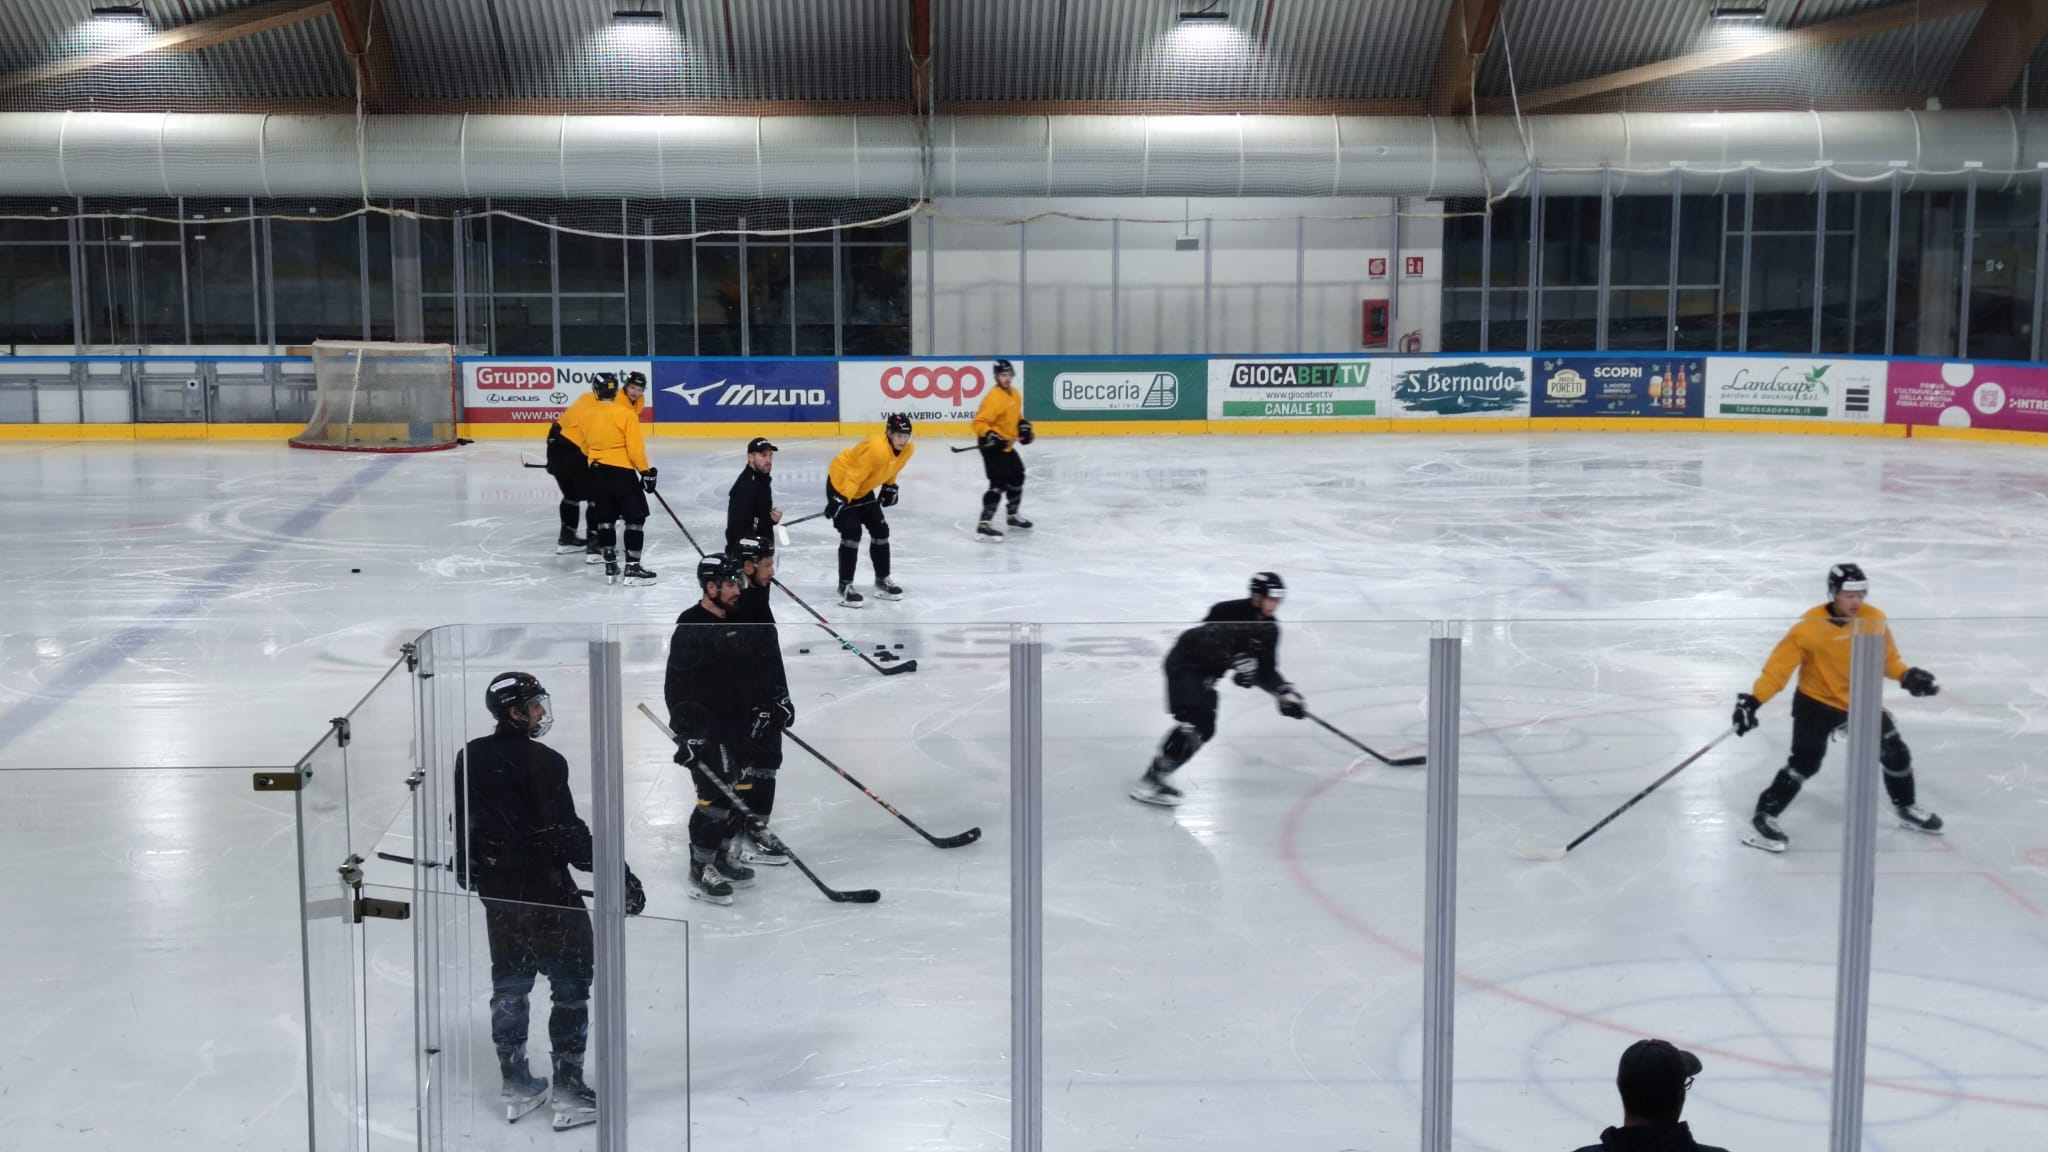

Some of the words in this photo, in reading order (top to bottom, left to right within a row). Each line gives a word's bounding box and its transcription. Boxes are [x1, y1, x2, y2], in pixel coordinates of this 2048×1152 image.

[478, 367, 551, 388] Gruppo
[1236, 365, 1367, 385] GIOCABET.TV
[1594, 367, 1642, 377] SCOPRI
[880, 366, 986, 406] coop
[1062, 380, 1140, 400] Beccaria
[1551, 382, 1582, 393] PORETTI
[1721, 366, 1815, 400] Landscape
[1266, 391, 1333, 400] www.giocabet.tv
[1264, 403, 1313, 415] CANALE
[1316, 402, 1334, 414] 113
[1736, 405, 1811, 415] landscapeweb.it
